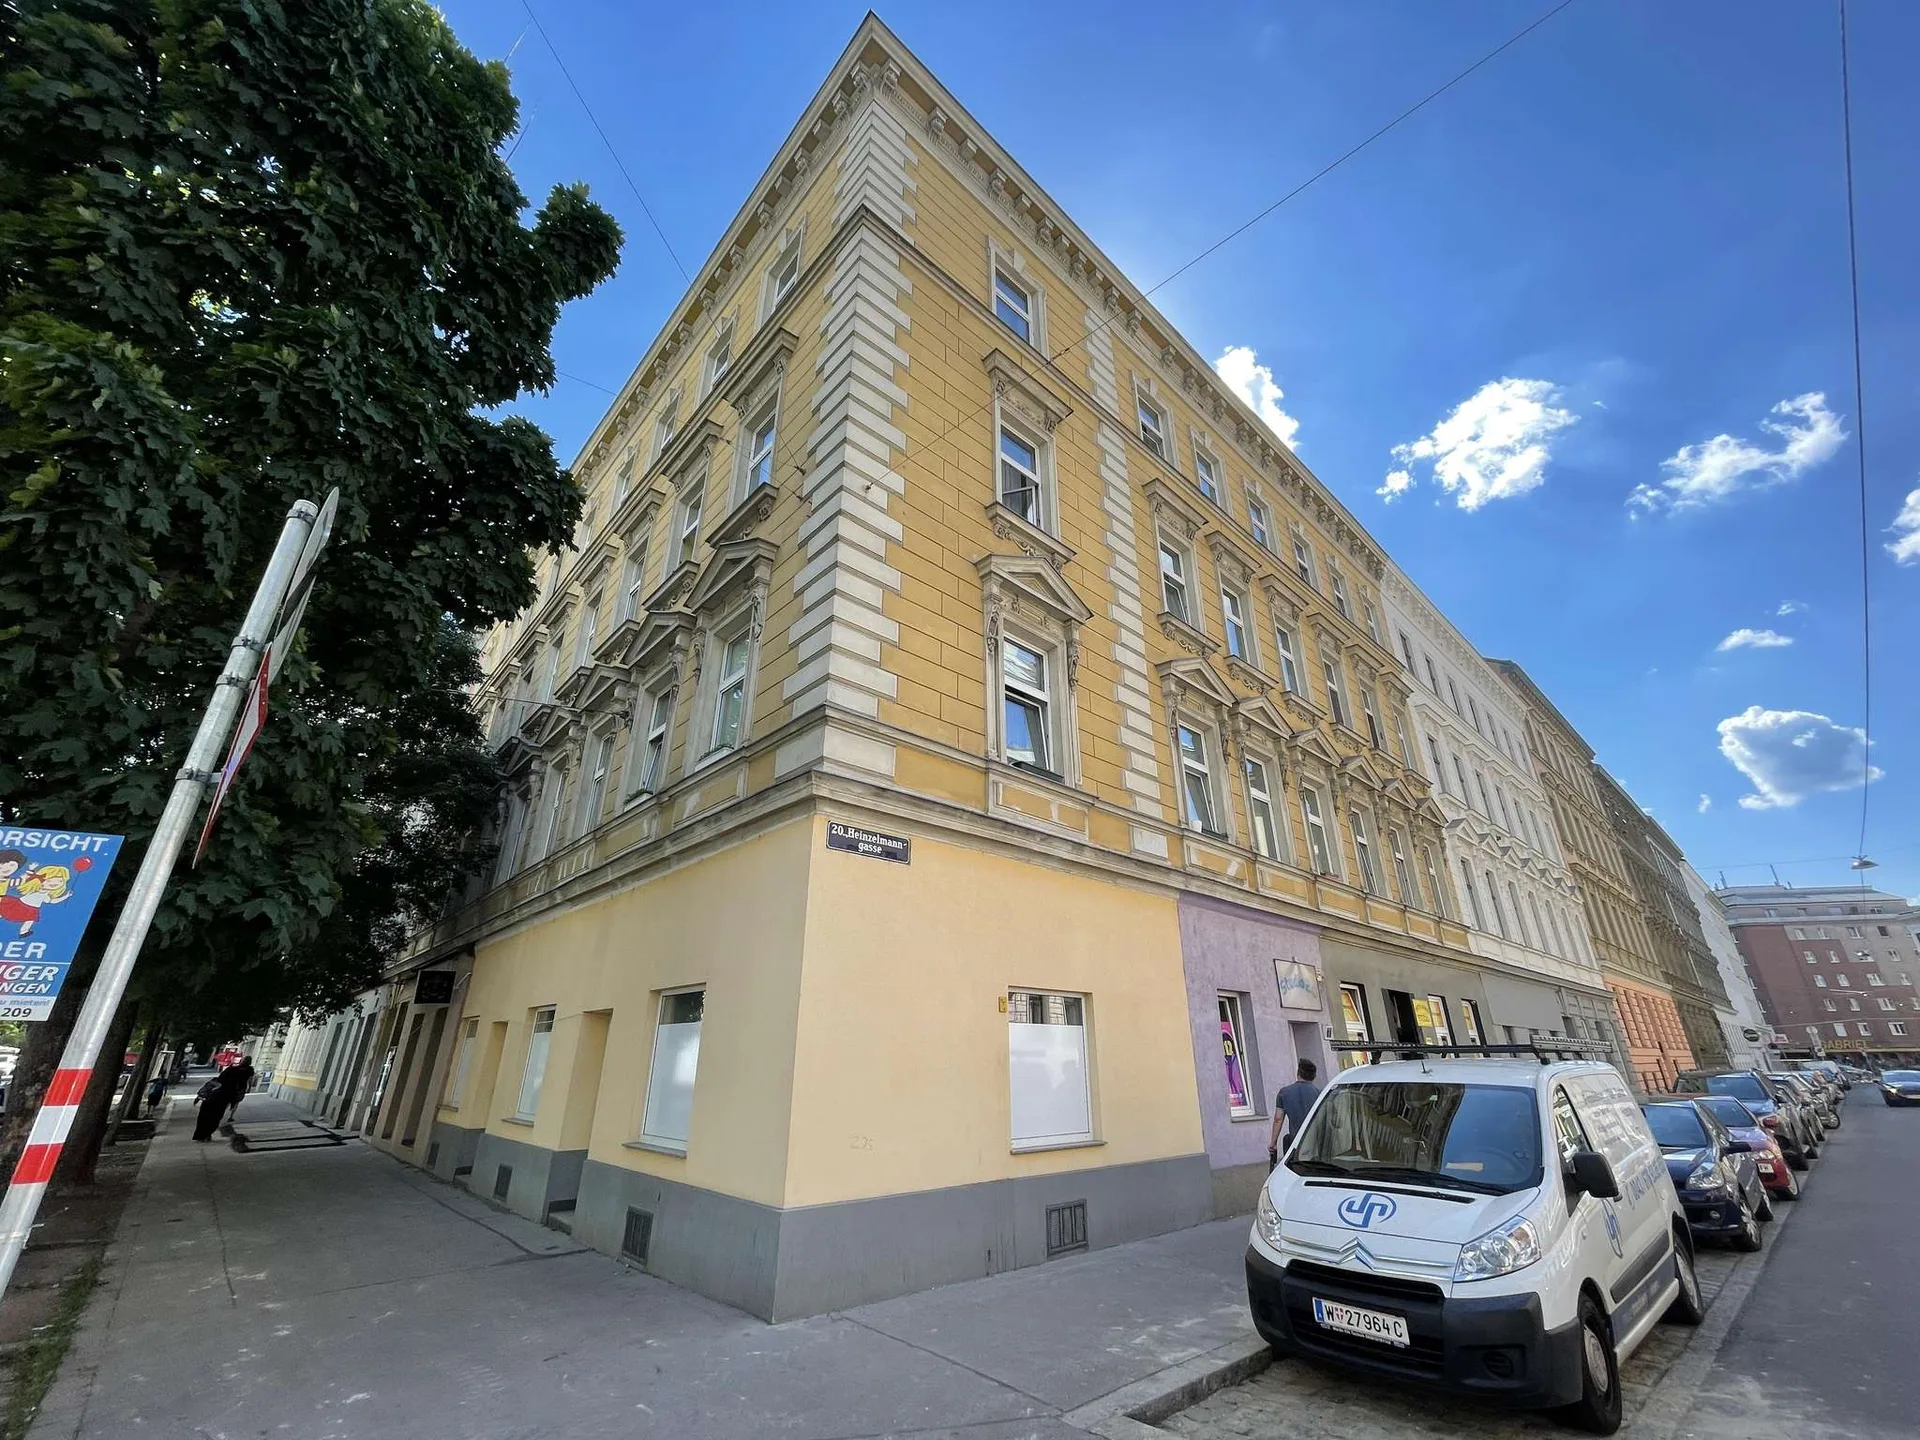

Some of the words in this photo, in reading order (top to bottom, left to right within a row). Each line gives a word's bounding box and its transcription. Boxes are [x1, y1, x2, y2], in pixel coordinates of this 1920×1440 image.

[0, 829, 109, 852] RSICHT
[858, 842, 882, 855] gasse
[0, 941, 47, 959] ER
[0, 964, 59, 982] GER
[1, 1007, 32, 1018] 209
[1324, 1304, 1335, 1322] W
